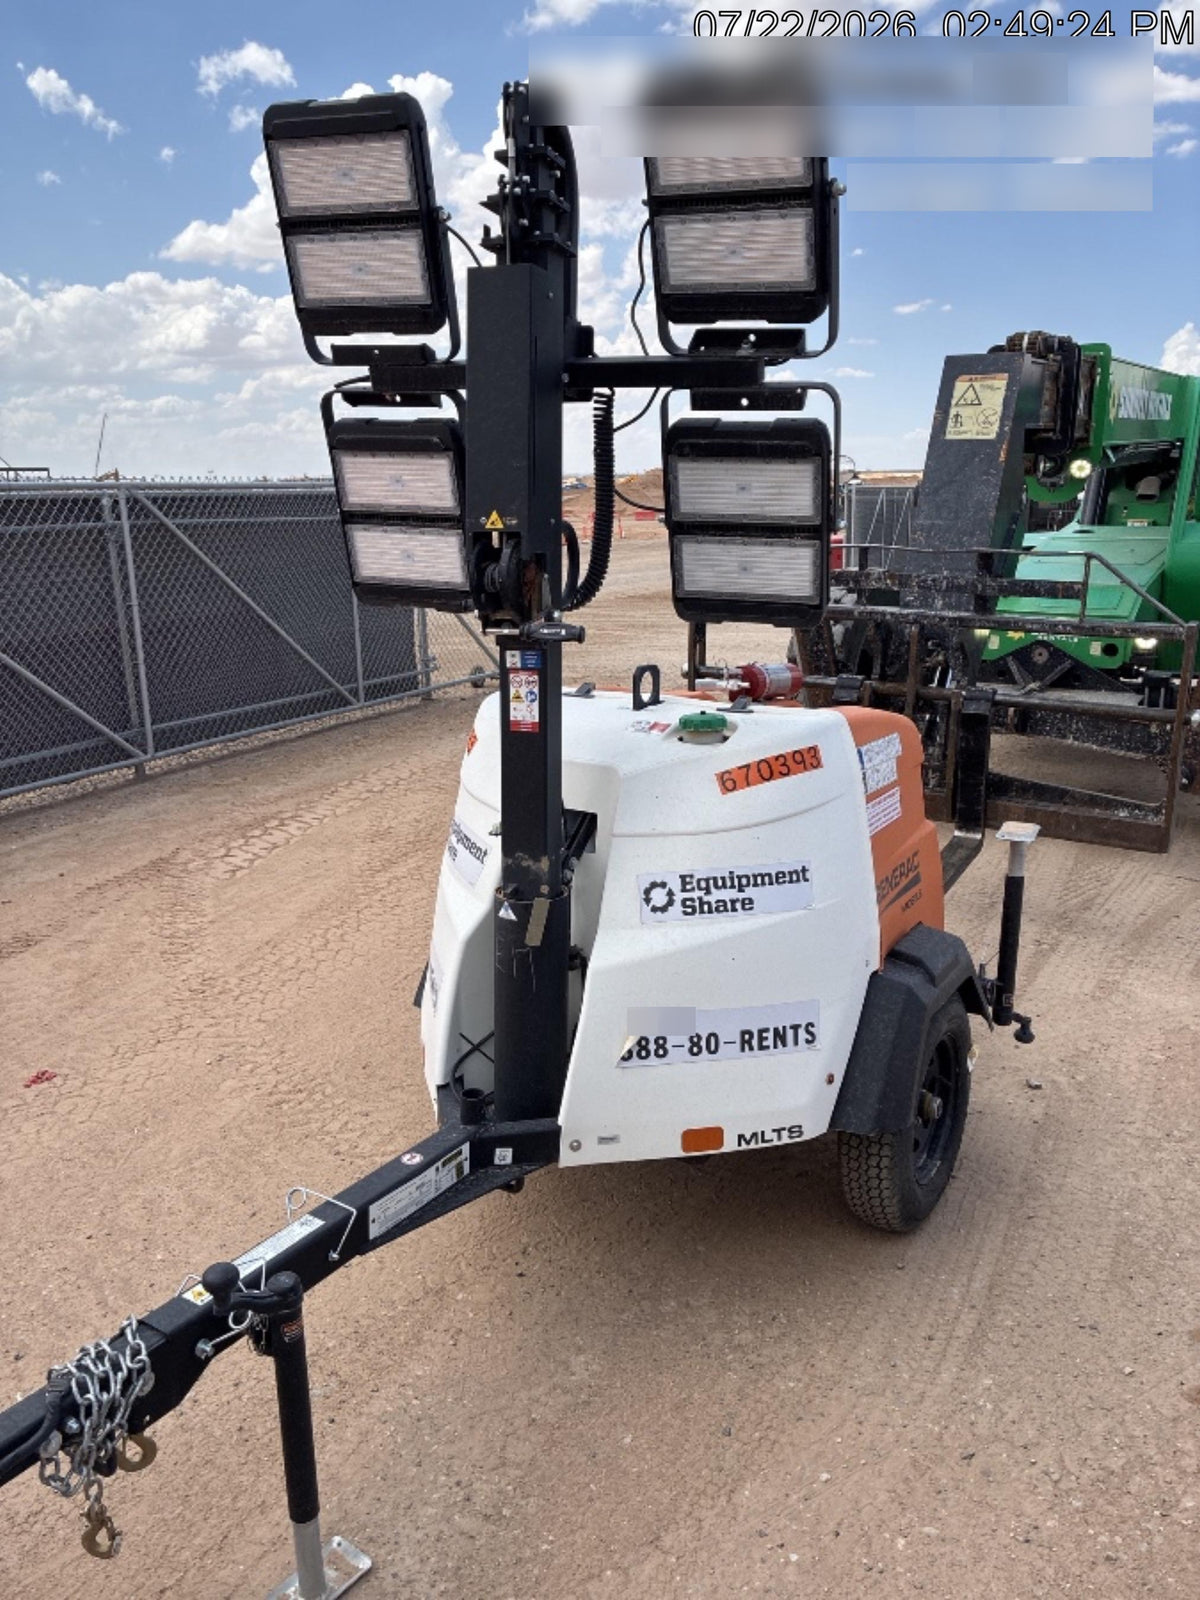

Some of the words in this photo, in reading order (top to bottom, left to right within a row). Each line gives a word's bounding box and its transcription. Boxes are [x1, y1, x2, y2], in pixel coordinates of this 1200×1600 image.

[719, 746, 821, 793] 670393
[678, 865, 810, 895] Equipment
[680, 892, 756, 917] Share
[737, 1124, 804, 1147] MLTS
